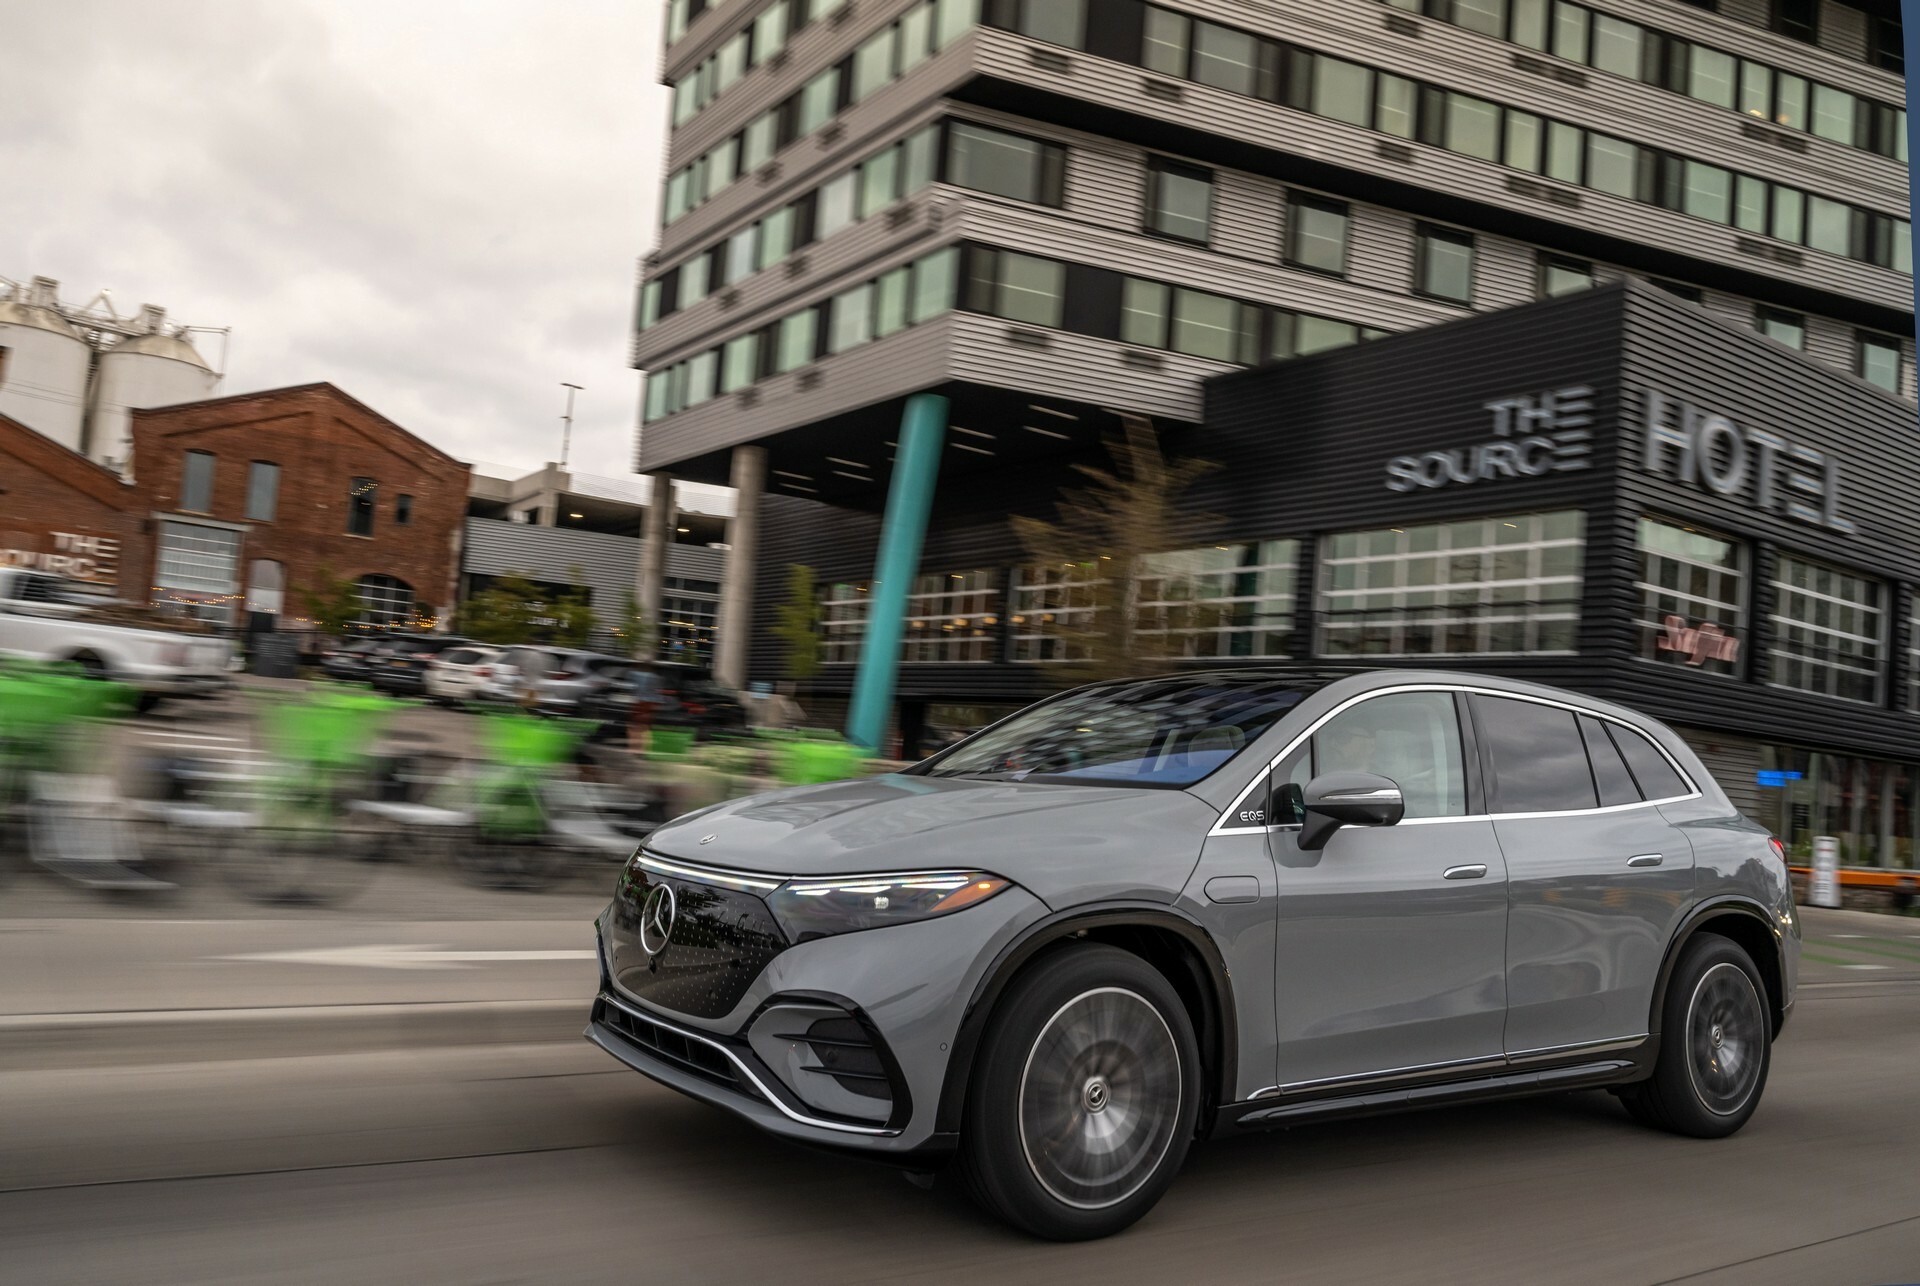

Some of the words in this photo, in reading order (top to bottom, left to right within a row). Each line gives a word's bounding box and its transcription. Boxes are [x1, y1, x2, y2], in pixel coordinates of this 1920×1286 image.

[1484, 384, 1595, 437] THE
[1385, 430, 1595, 493] SOURCE
[1645, 387, 1857, 535] HOTEL
[48, 530, 120, 558] THE
[1239, 810, 1265, 822] EQS
